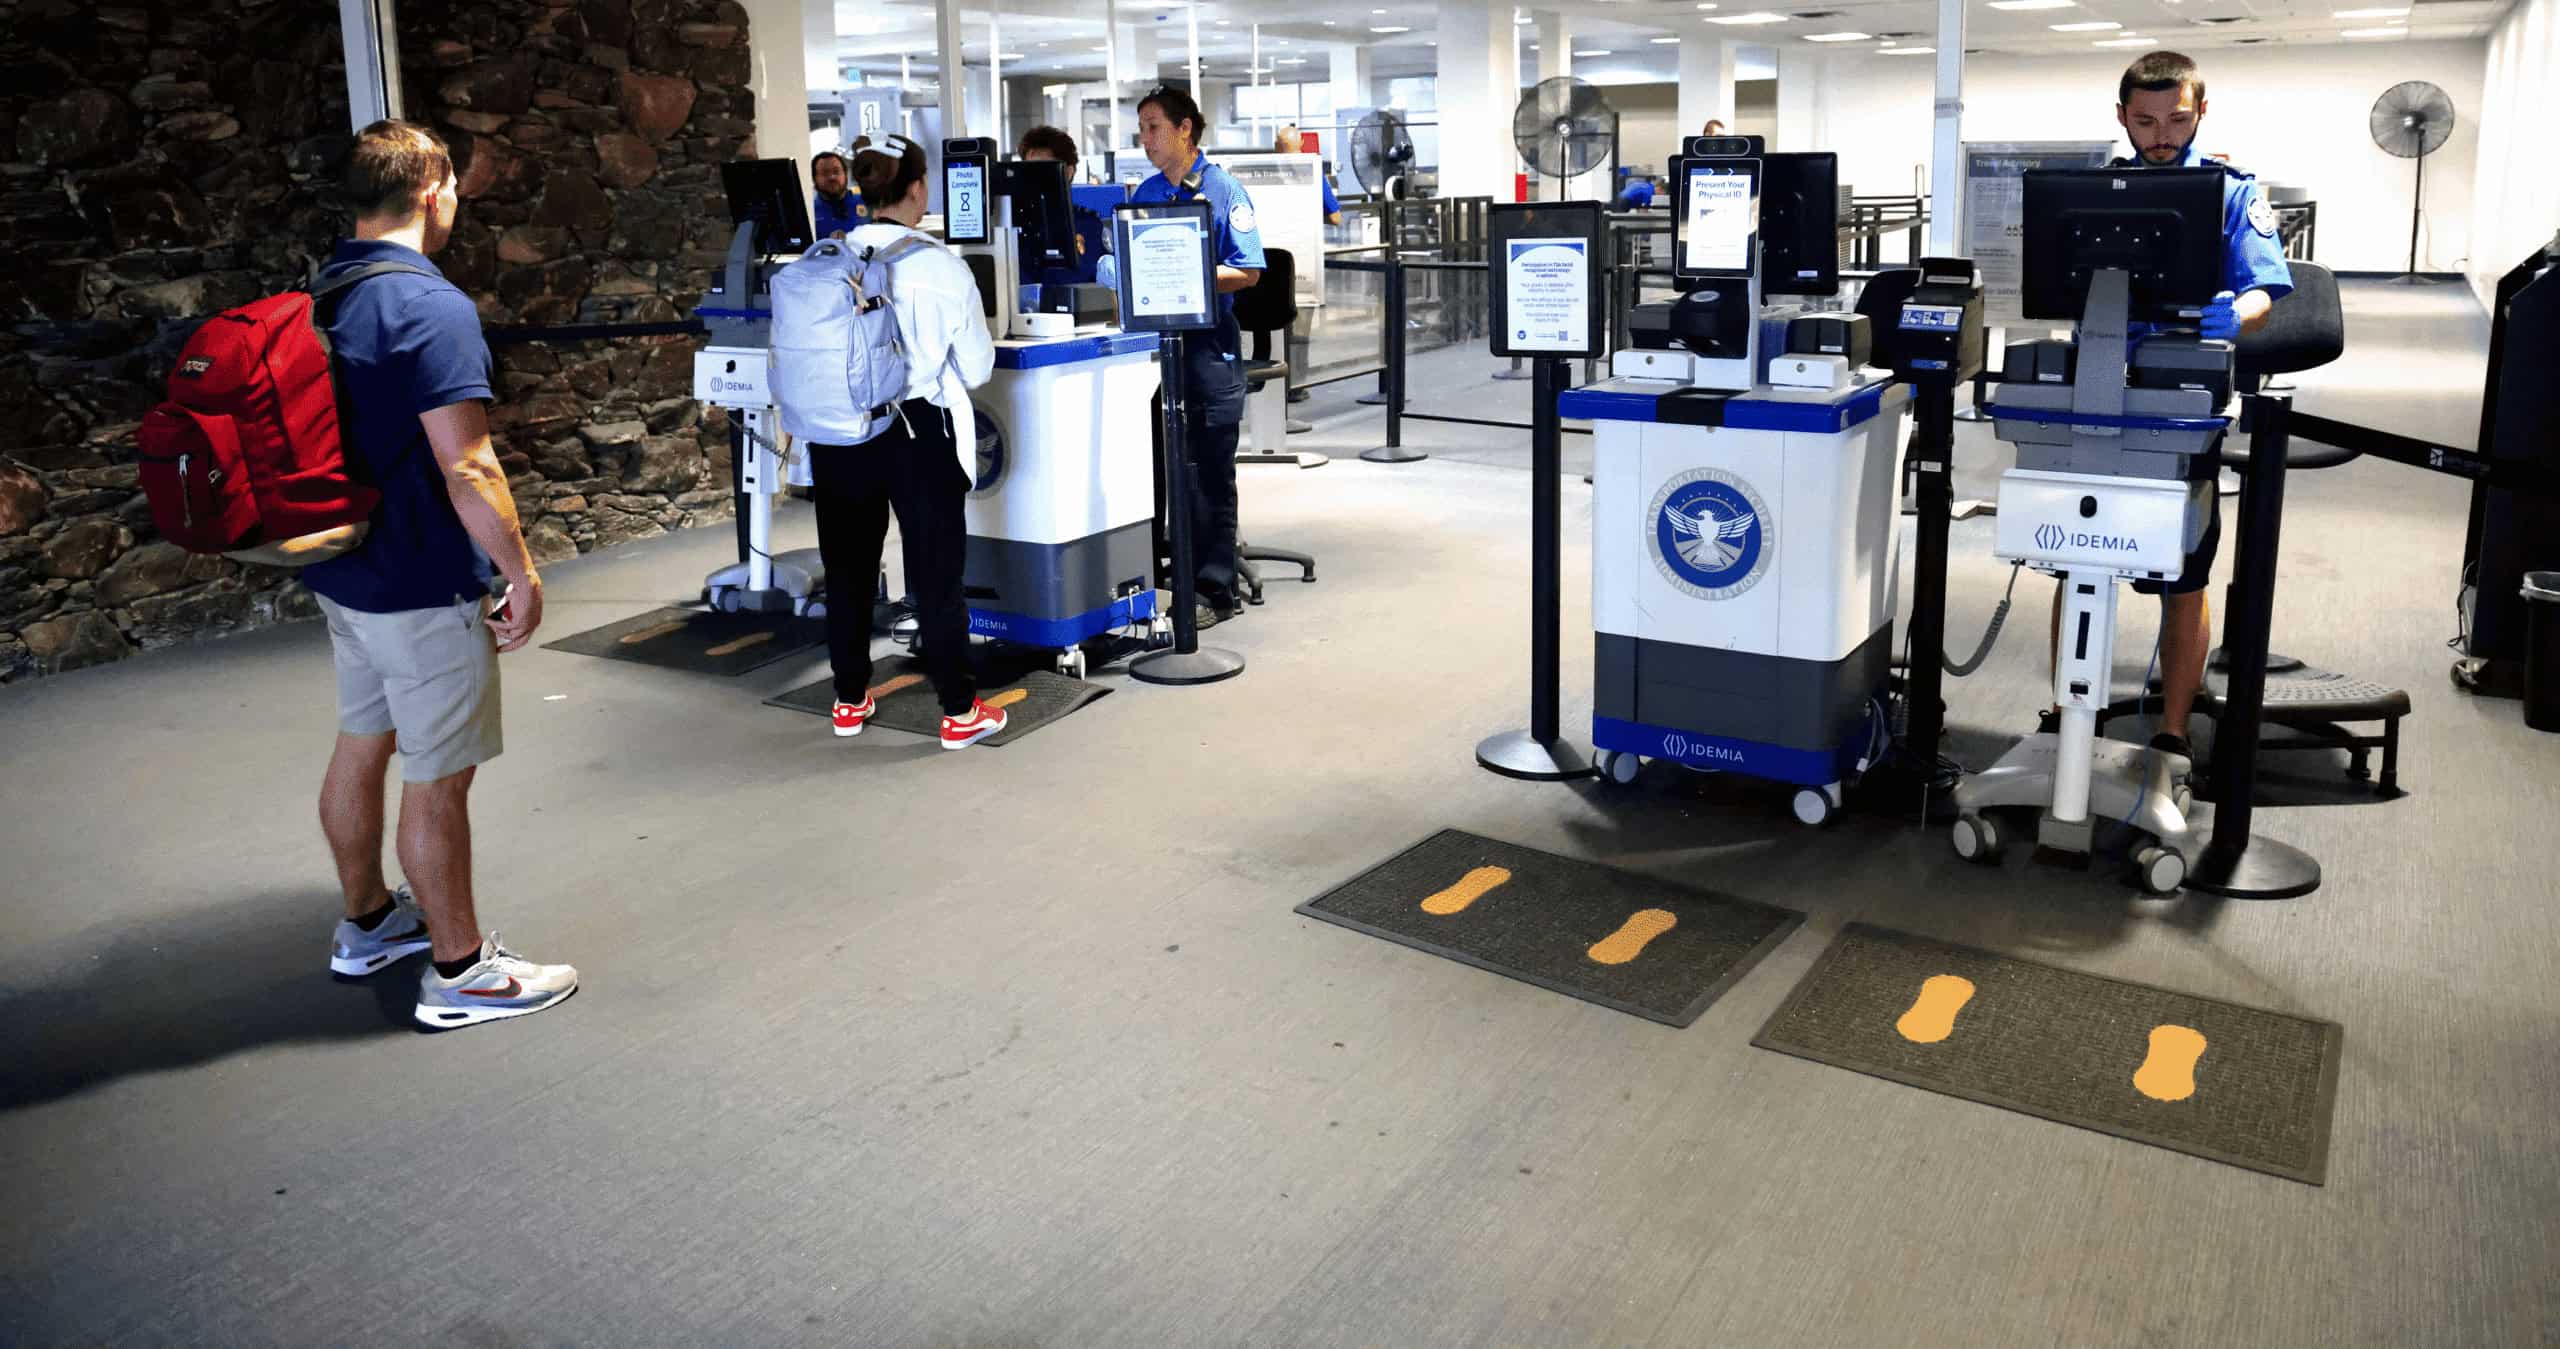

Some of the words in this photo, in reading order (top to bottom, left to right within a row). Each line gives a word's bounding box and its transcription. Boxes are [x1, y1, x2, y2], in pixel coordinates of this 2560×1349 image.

[864, 103, 876, 133] 1
[1696, 180, 1726, 189] Present
[1728, 180, 1745, 189] Your
[1699, 190, 1731, 200] Physical
[1733, 191, 1742, 199] ID
[725, 381, 753, 391] IDEMIA
[2070, 533, 2138, 552] IDEMIA
[975, 618, 1008, 631] IDEMIA
[1691, 743, 1744, 763] IDEMIA
